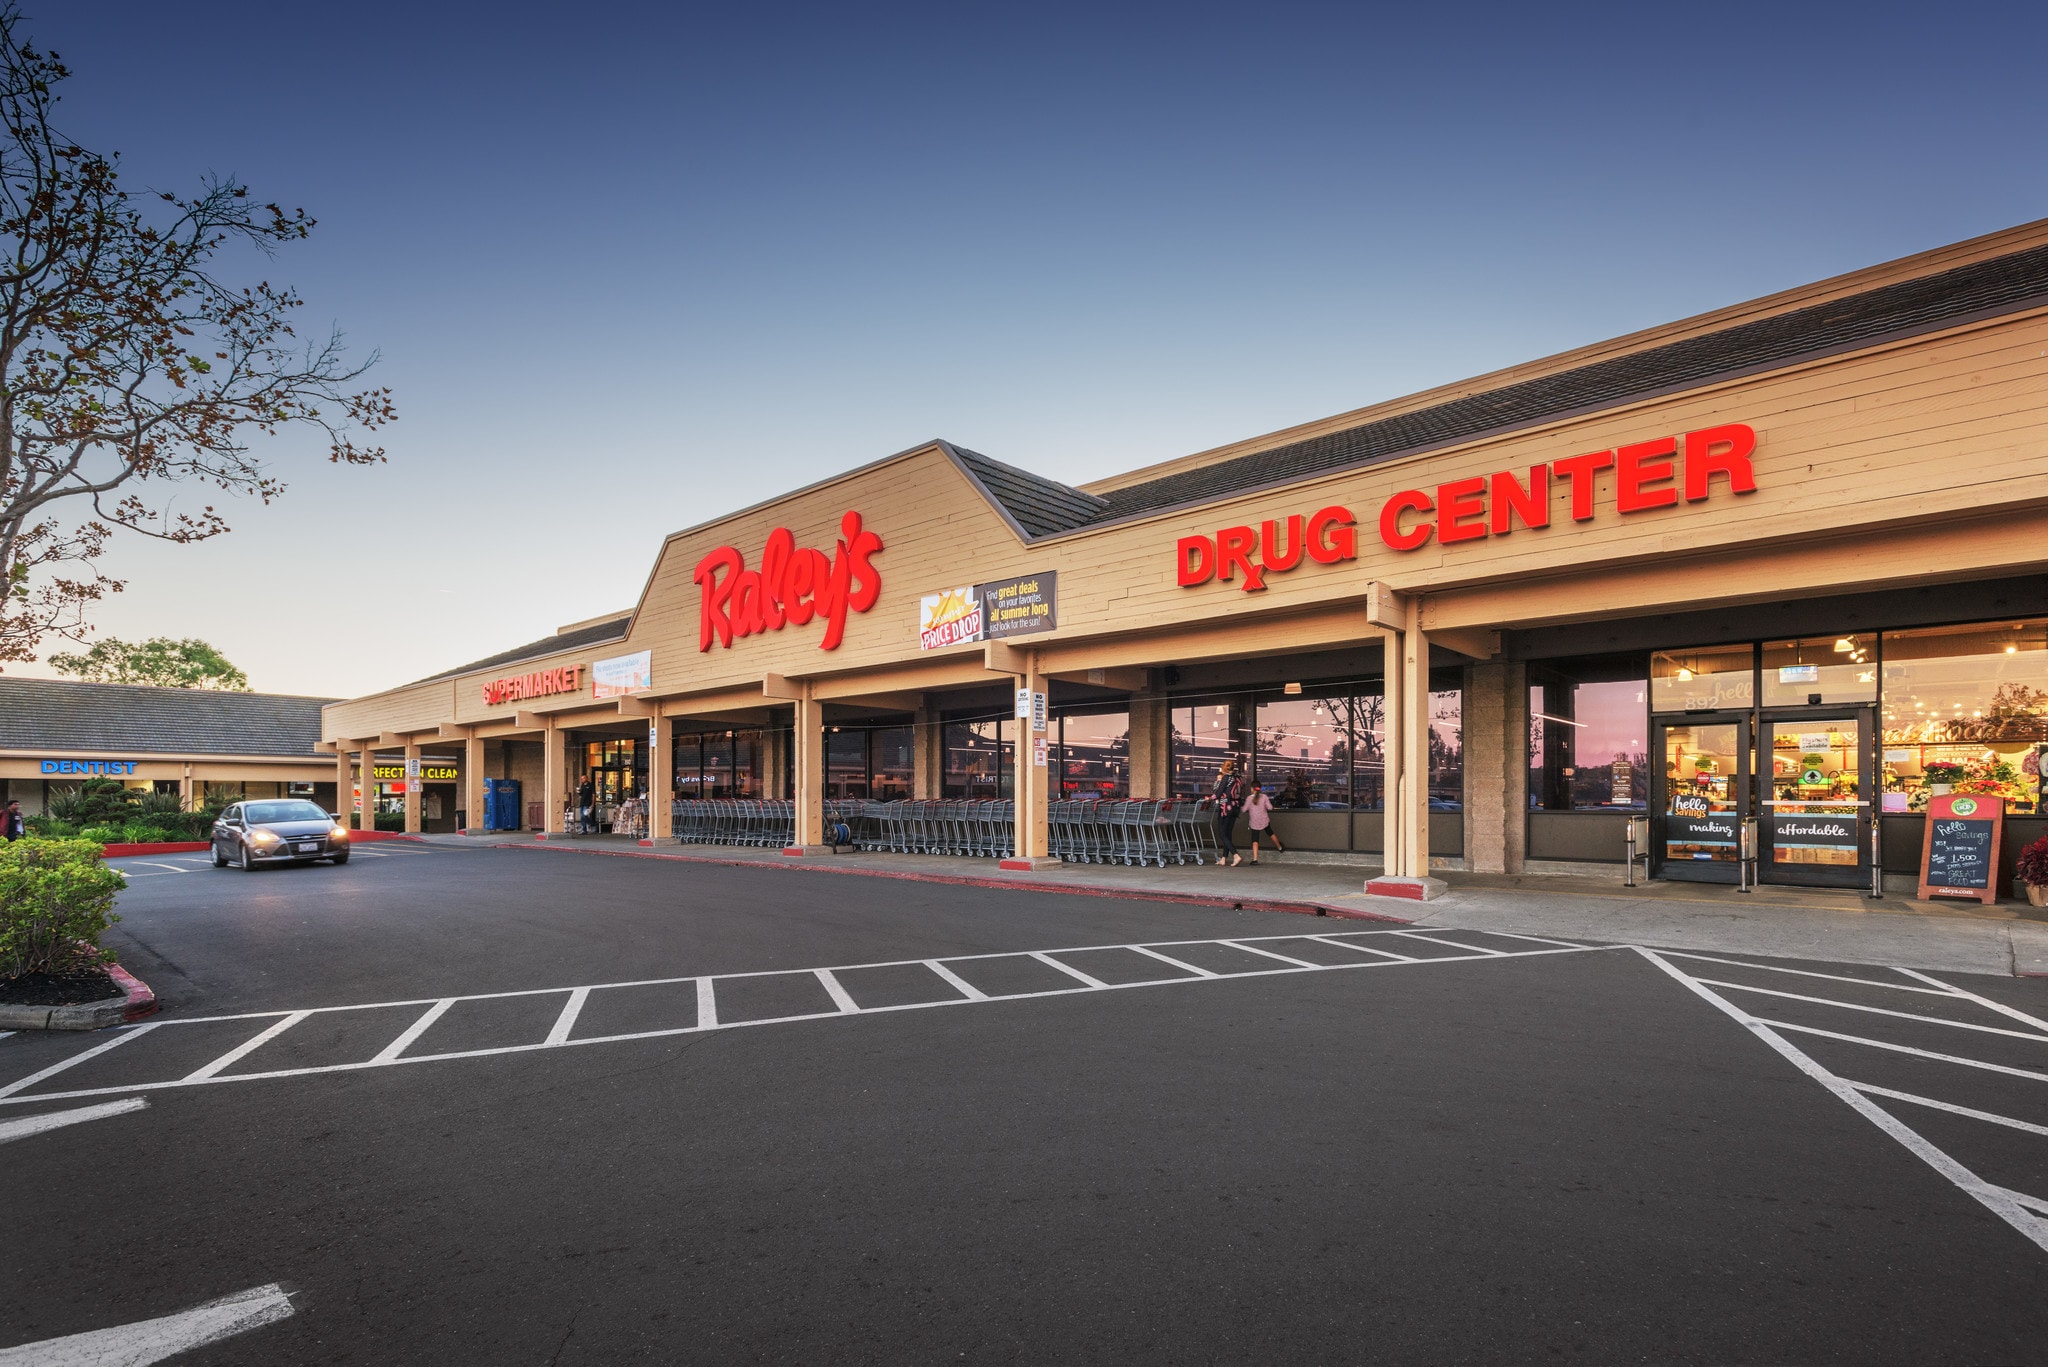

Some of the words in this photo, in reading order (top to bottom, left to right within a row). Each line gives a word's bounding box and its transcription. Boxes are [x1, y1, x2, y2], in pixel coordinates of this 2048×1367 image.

[1379, 424, 1757, 551] CENTER
[694, 511, 884, 652] Raley's
[987, 589, 998, 600] Find
[998, 583, 1017, 600] great
[1019, 580, 1039, 595] deals
[999, 600, 1006, 608] on
[1006, 597, 1018, 608] your
[1019, 594, 1042, 605] favorites
[990, 608, 1000, 622] all
[1001, 605, 1030, 620] summer
[1031, 603, 1049, 616] long
[1000, 620, 1010, 631] look
[1019, 618, 1029, 628] the
[1029, 616, 1041, 627] sun!
[921, 623, 950, 650] PRICE
[951, 613, 980, 640] DROP
[482, 664, 582, 705] SUPERMARKET
[1715, 681, 1754, 701] hell
[1685, 696, 1719, 710] 892
[41, 761, 138, 775] DENTIST
[1676, 795, 1707, 810] hello
[1674, 808, 1707, 819] savings
[1689, 821, 1734, 837] making
[1777, 823, 1849, 836] affordable.
[1937, 821, 1966, 836] hello
[1938, 887, 1974, 895] raleys.com
